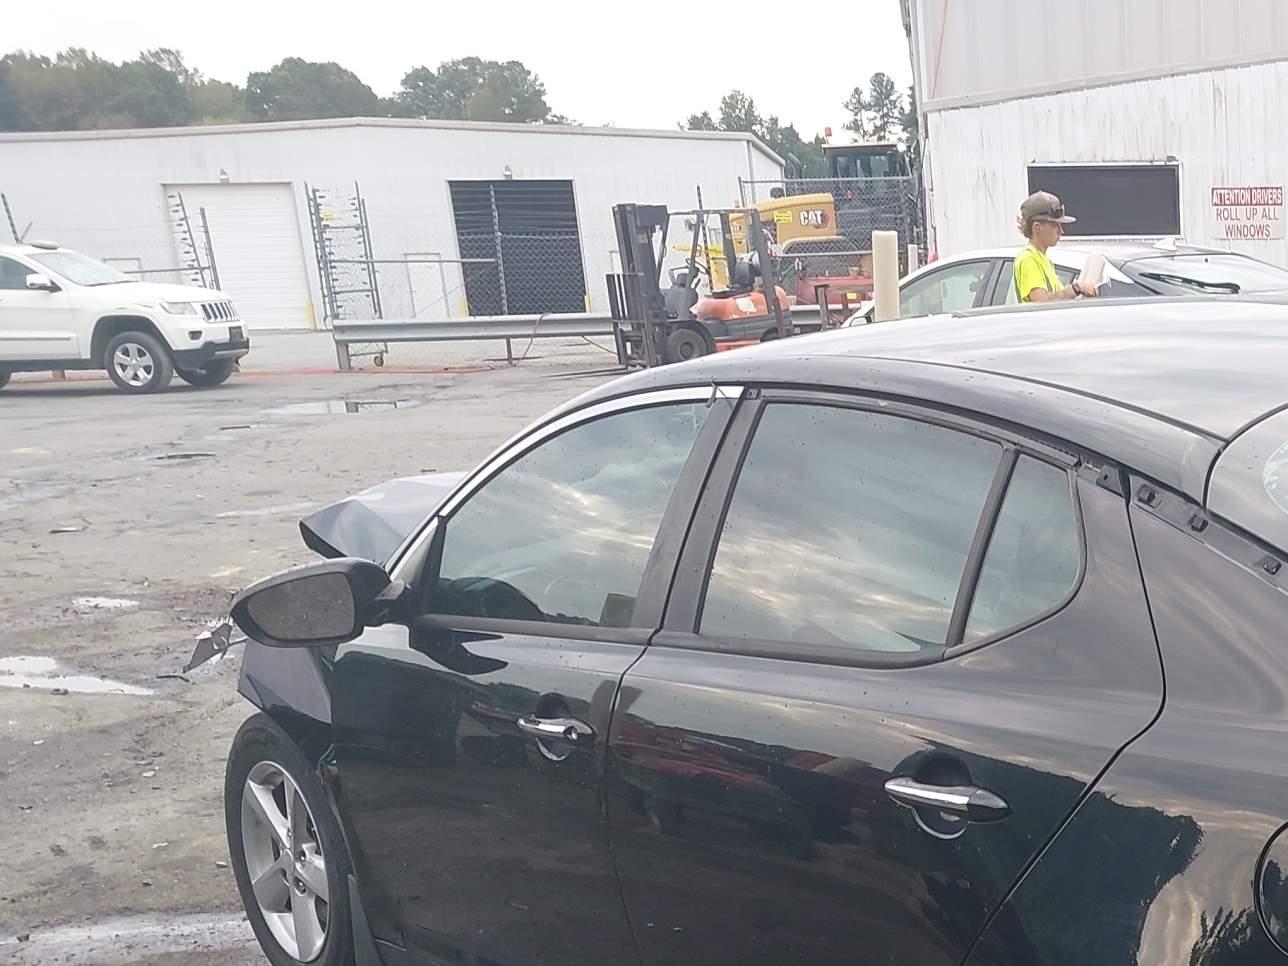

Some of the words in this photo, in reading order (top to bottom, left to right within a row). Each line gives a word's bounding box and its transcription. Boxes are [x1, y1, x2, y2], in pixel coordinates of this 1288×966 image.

[1213, 188, 1251, 205] ATTENTION
[1251, 188, 1282, 205] DRIVERS
[800, 210, 823, 226] CAT
[1216, 207, 1241, 221] ROLL
[1245, 207, 1258, 221] UP
[1261, 207, 1279, 221] ALL
[1225, 223, 1271, 238] WINDOWS
